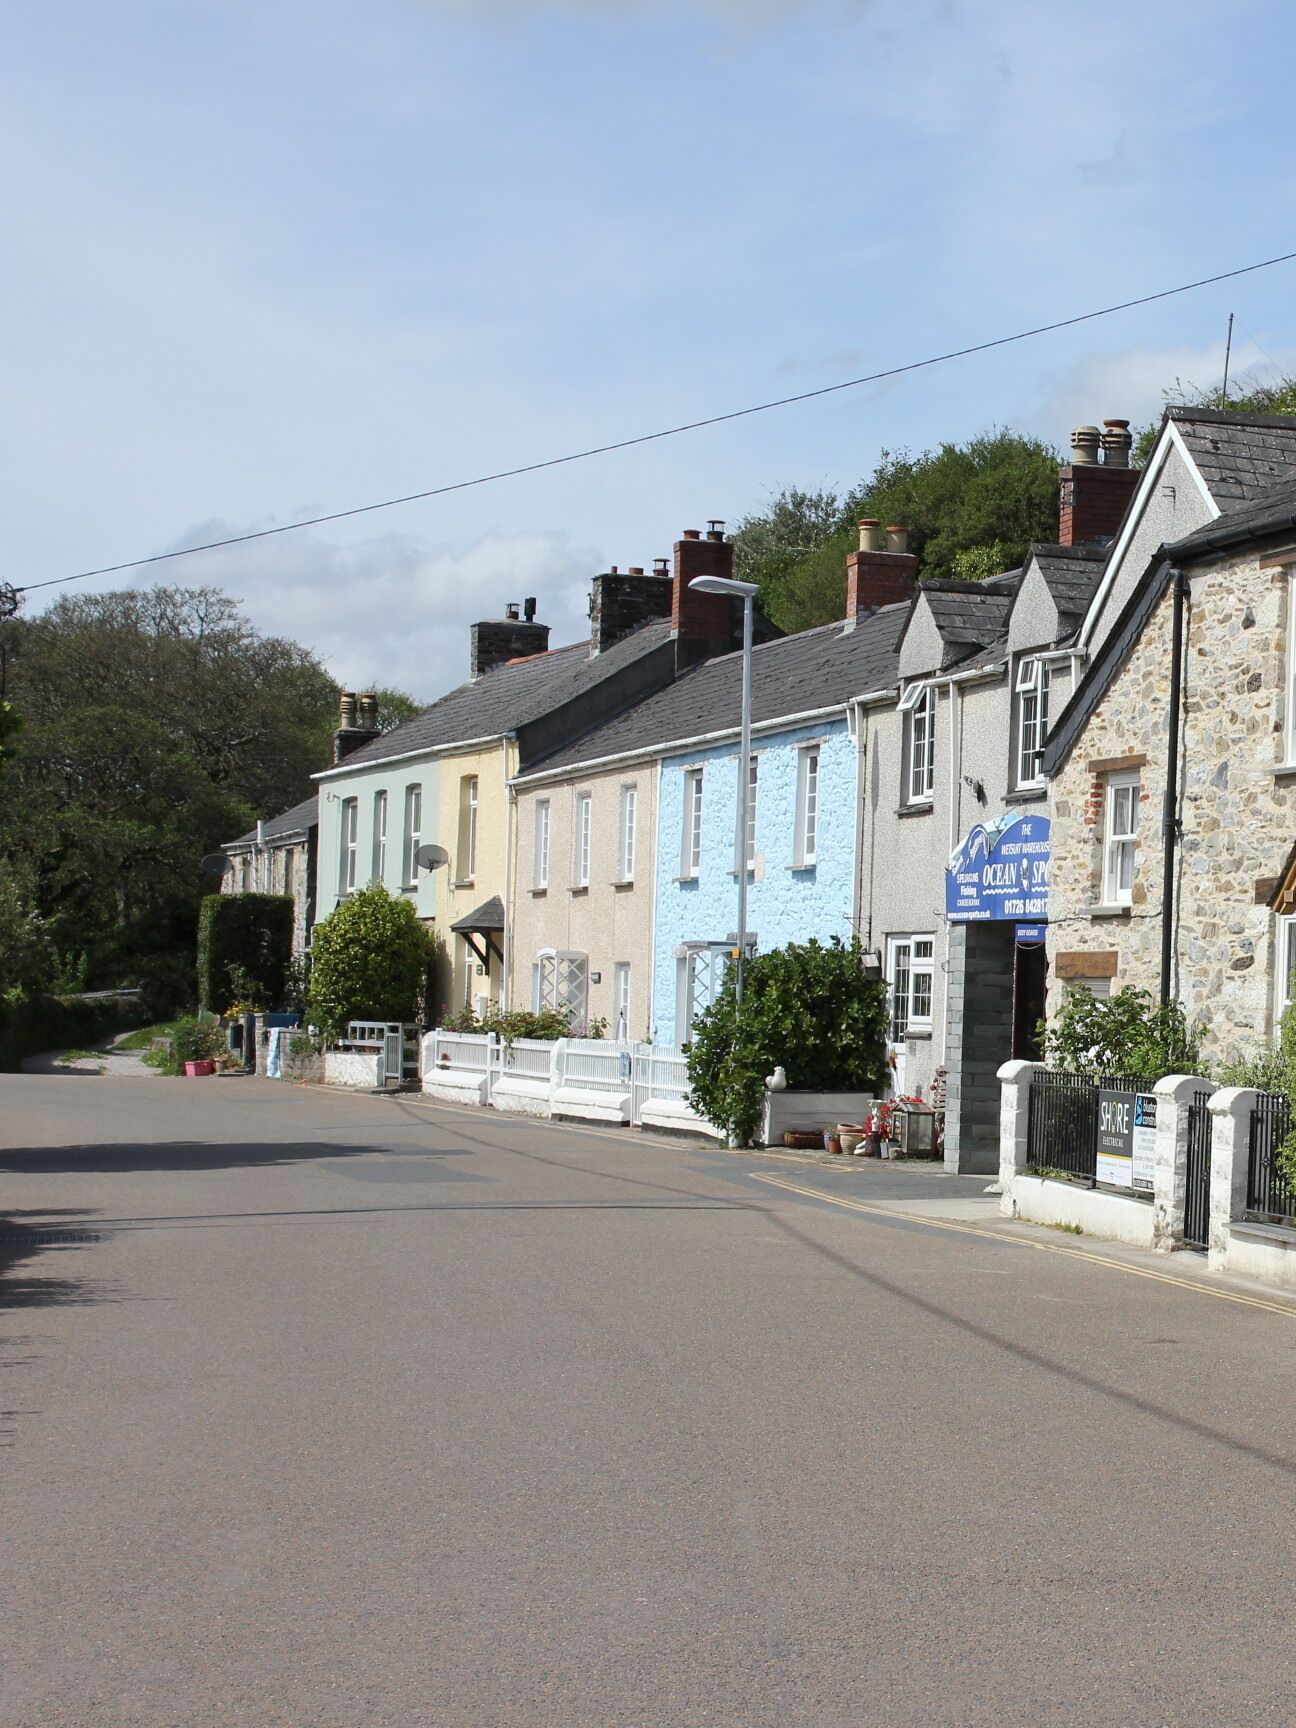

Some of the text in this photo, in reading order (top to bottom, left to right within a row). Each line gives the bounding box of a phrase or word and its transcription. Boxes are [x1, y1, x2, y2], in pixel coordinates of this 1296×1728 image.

[1022, 824, 1032, 835] THE
[1001, 841, 1050, 855] WETSUIT WAREHOUS
[983, 863, 1017, 886] OCEAN
[960, 886, 976, 897] Fishing
[1004, 899, 1024, 914] 01726
[1100, 1101, 1130, 1134] SHORE
[1102, 1136, 1123, 1148] ELECTRICAL
